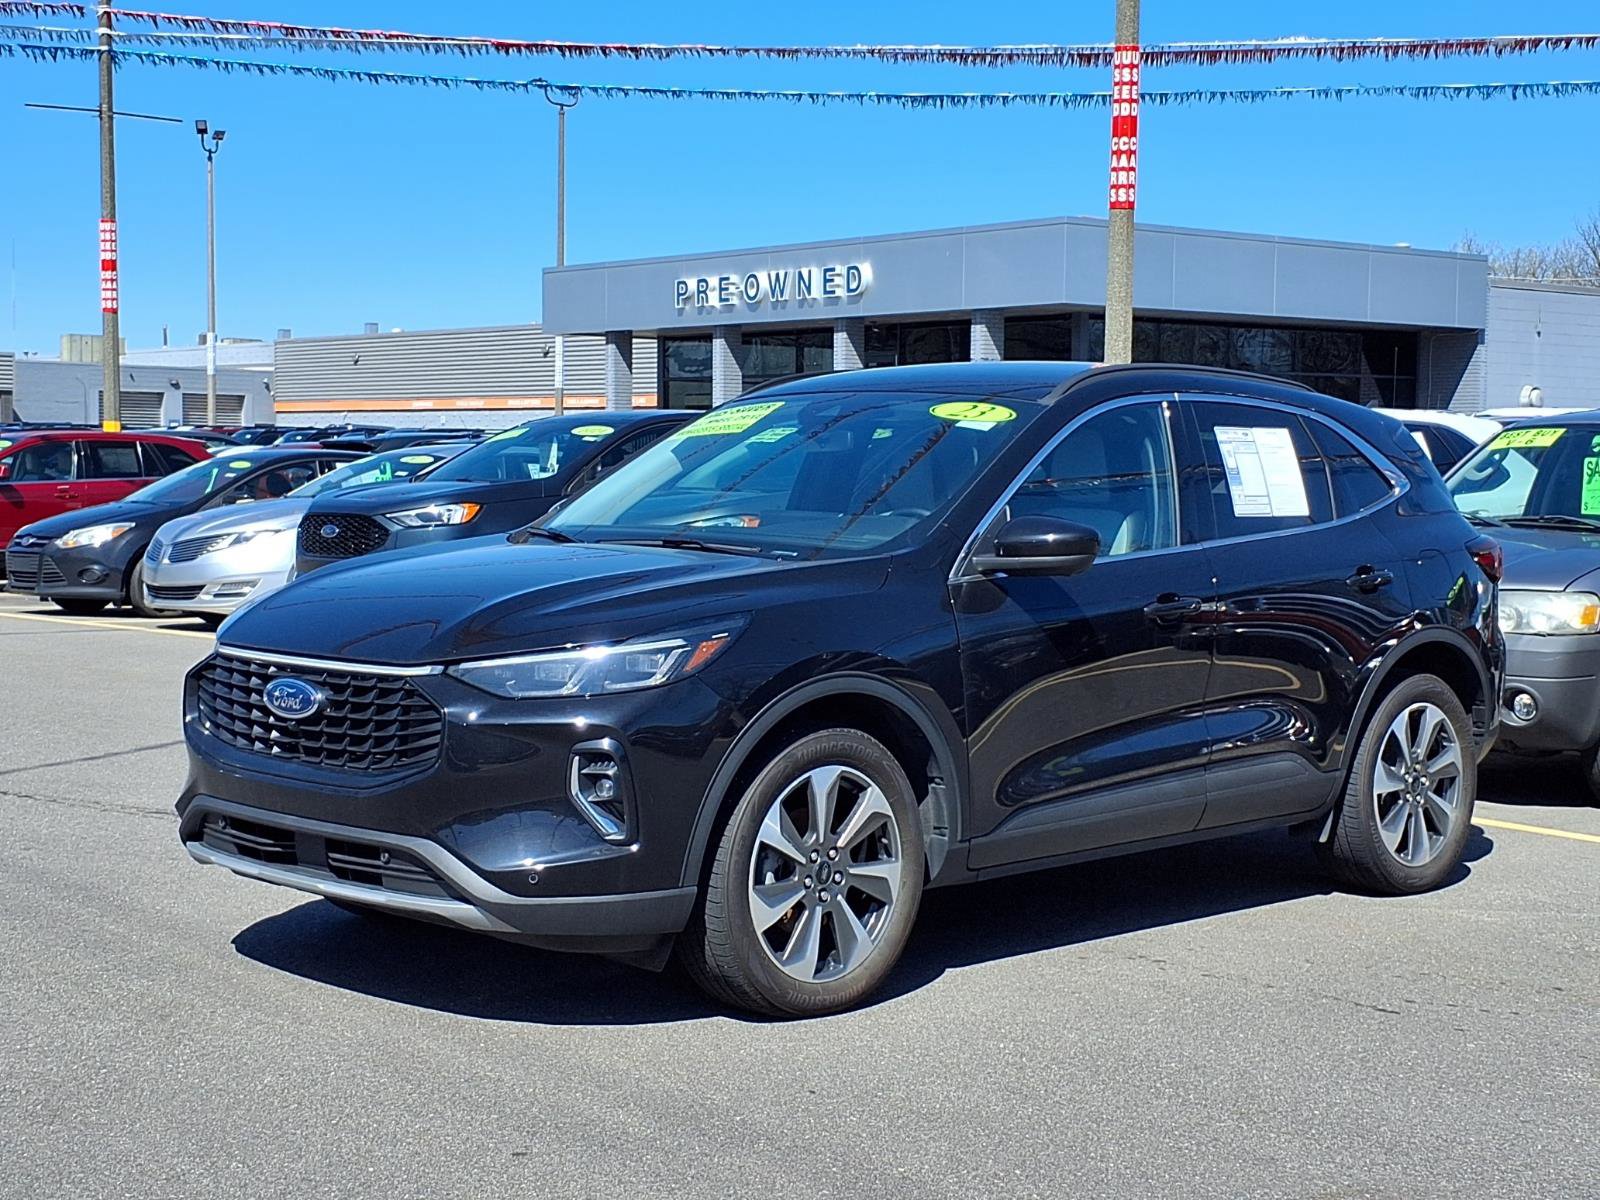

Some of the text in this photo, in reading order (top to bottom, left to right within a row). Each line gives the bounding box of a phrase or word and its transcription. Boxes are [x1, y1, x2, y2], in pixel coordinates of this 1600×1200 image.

[674, 264, 863, 308] PRE-OWNED
[944, 404, 998, 419] 23
[273, 686, 304, 710] Ford
[798, 741, 881, 762] BRIDGESTONE
